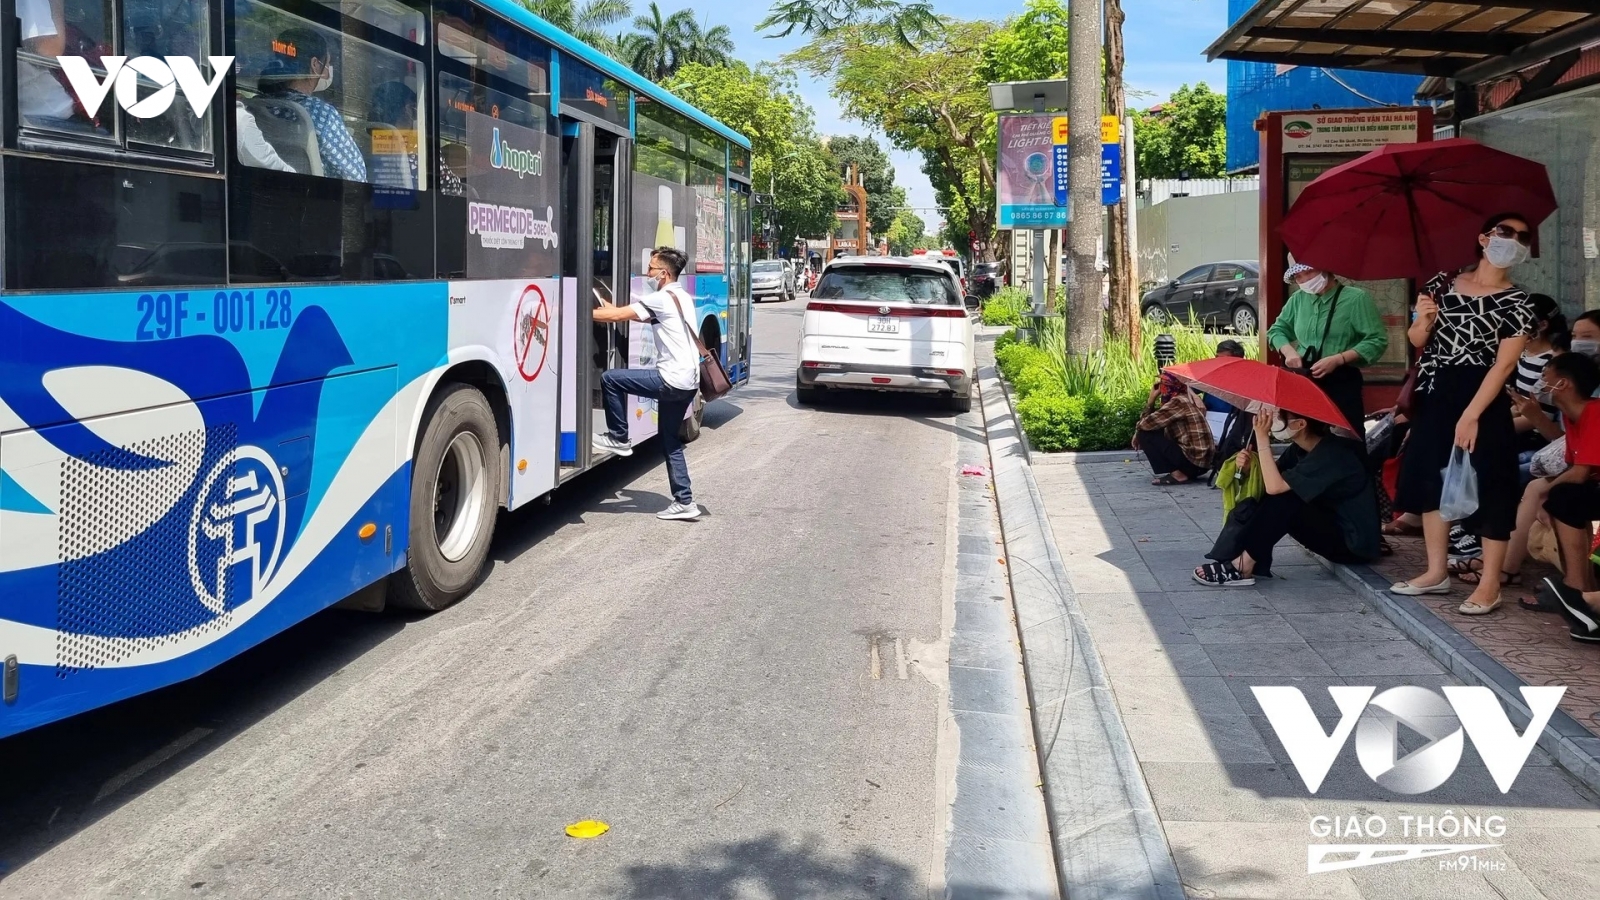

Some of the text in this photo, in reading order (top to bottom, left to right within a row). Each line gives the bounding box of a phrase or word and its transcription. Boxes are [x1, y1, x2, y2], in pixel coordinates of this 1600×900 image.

[1317, 116, 1326, 124] SỞ
[1367, 115, 1381, 124] VẬN
[1394, 114, 1403, 122] HÀ
[1404, 114, 1416, 123] NỘI
[1037, 120, 1053, 130] KIỆ
[1007, 137, 1040, 148] LIGHT
[1032, 211, 1043, 219] 86
[1044, 211, 1054, 219] 87
[1055, 211, 1067, 219] 86
[470, 206, 533, 235] PERMECIDE
[136, 293, 189, 341] 29F
[213, 290, 293, 335] 001.28
[871, 324, 896, 332] 272.83
